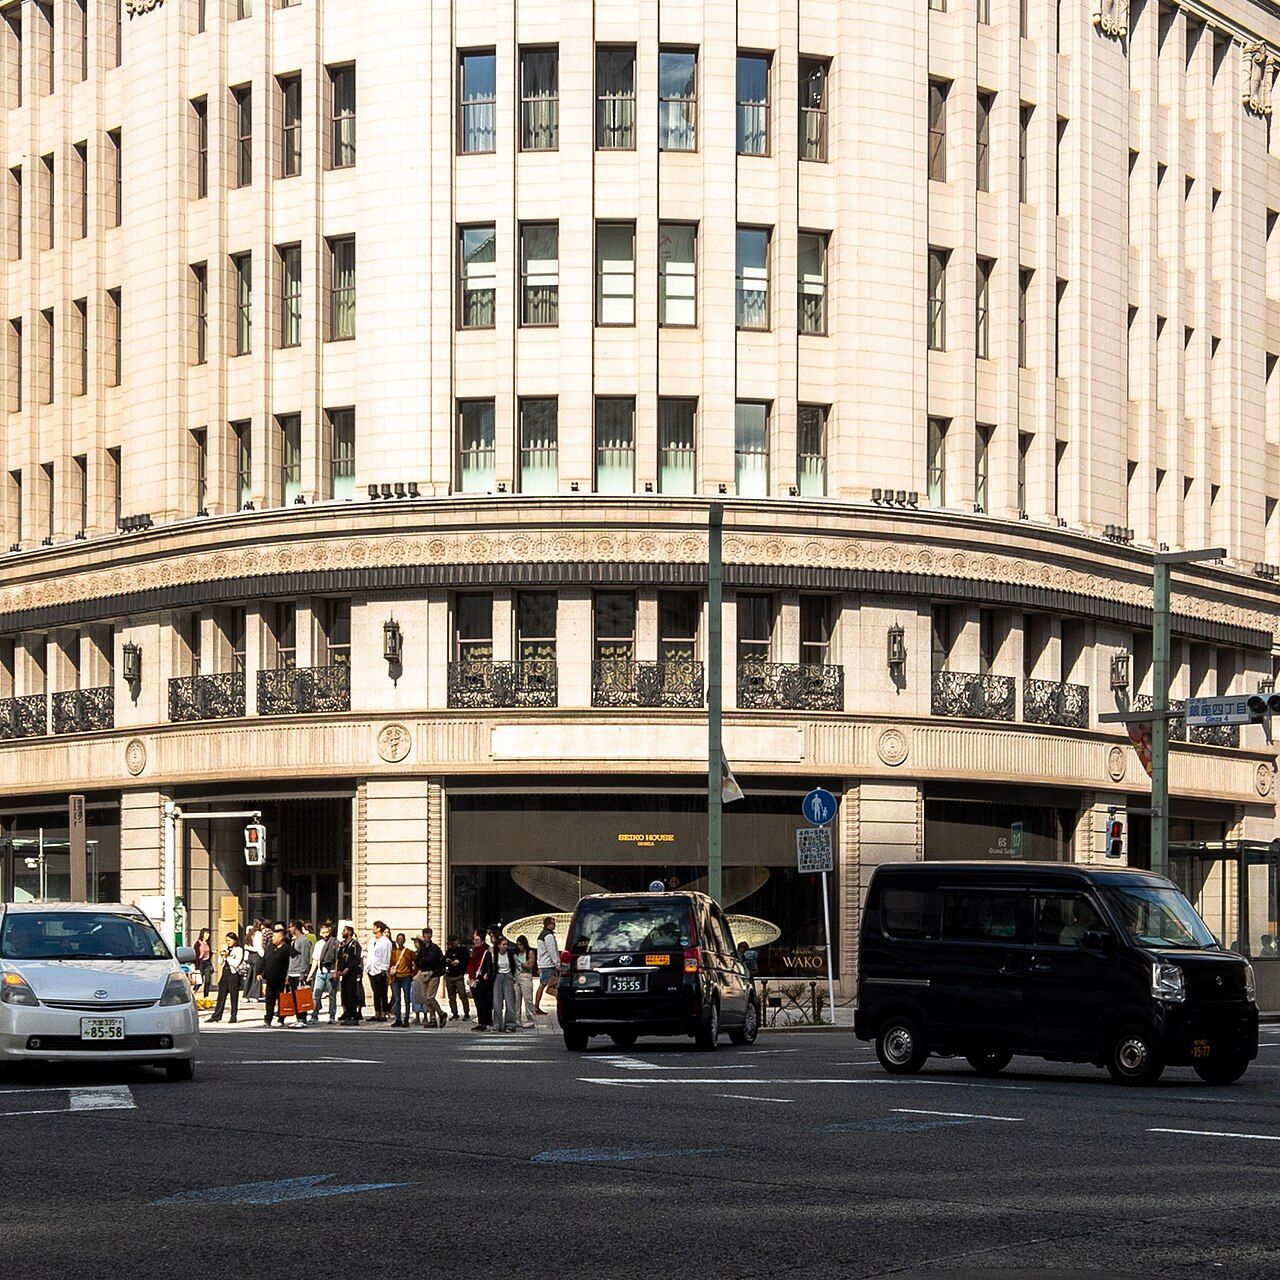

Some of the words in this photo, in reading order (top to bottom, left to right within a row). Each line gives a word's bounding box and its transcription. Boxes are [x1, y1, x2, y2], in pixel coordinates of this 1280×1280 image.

[1188, 702, 1247, 717] 銀座四丁目
[1205, 715, 1222, 723] Ginza
[782, 956, 823, 968] WAKO
[616, 981, 641, 991] 35-55
[90, 1026, 123, 1038] 85-58
